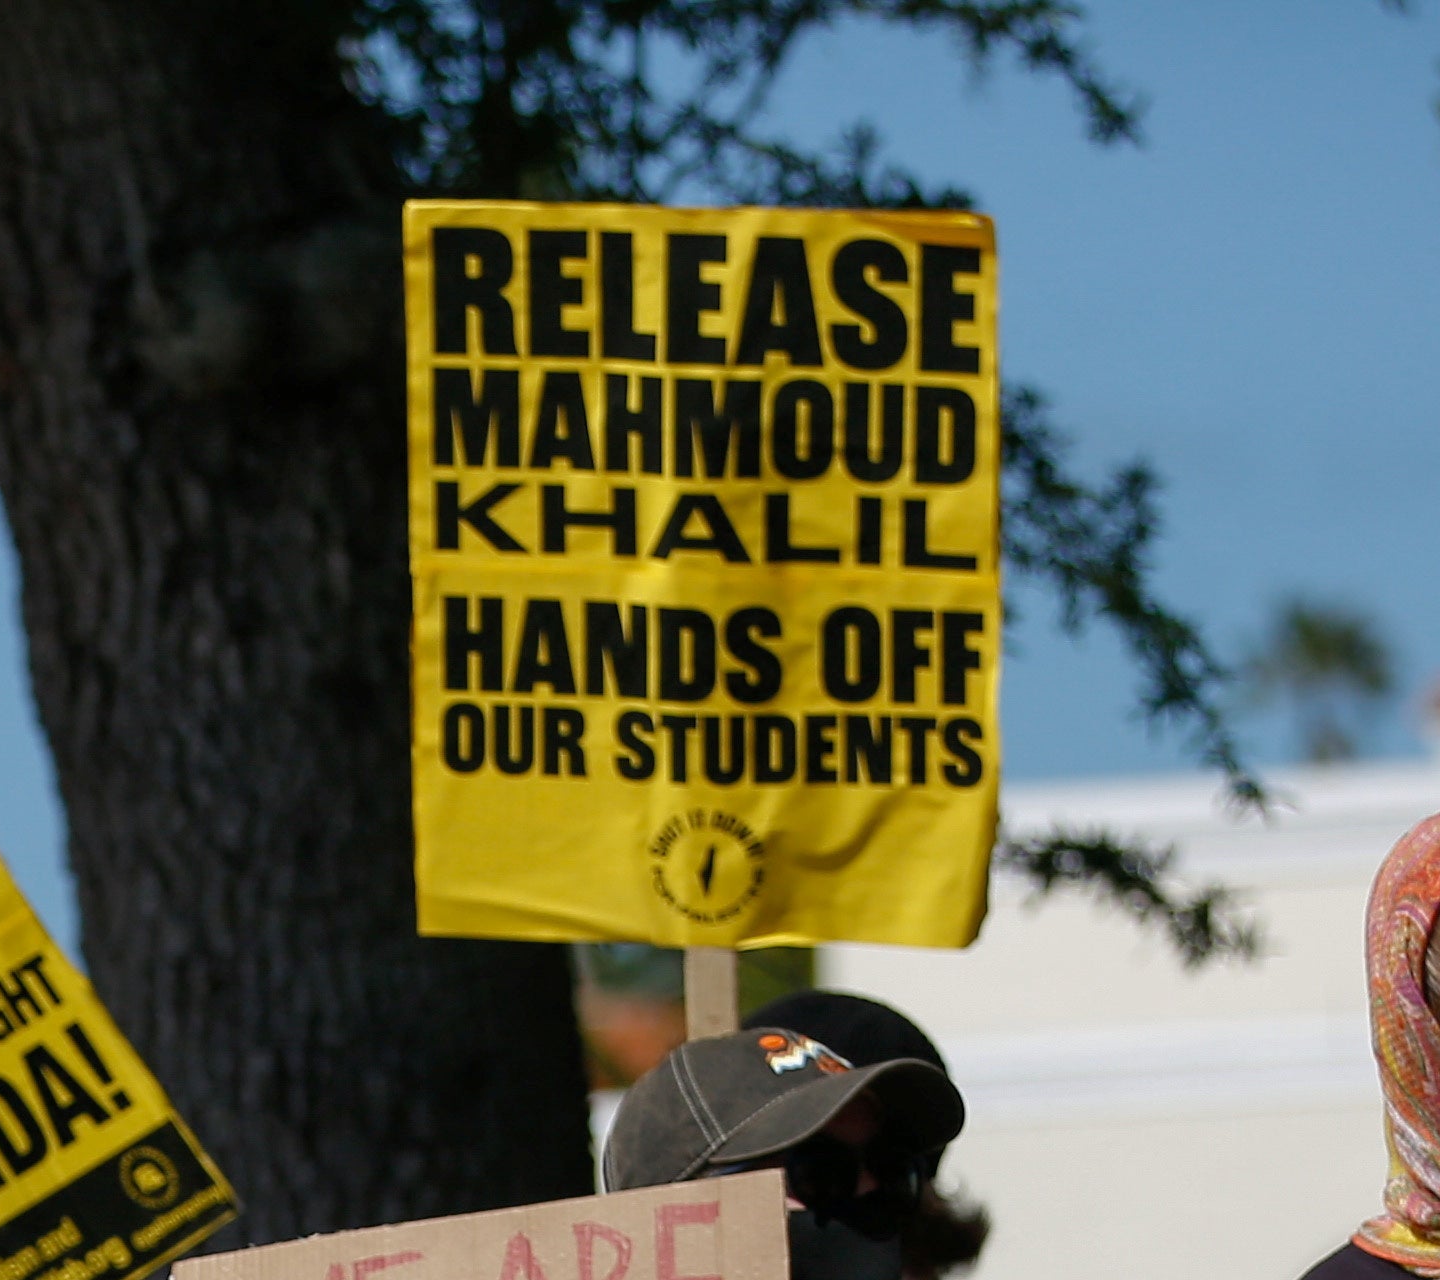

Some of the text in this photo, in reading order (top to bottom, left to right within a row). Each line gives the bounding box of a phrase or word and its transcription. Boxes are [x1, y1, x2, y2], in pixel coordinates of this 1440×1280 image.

[431, 227, 982, 373] RELEASE
[433, 369, 976, 484] MAHMOUD
[434, 482, 978, 570] KHALIL
[443, 595, 984, 705] HANDS OFF
[443, 702, 984, 787] OUR STUDENTS
[37, 1215, 83, 1260] and
